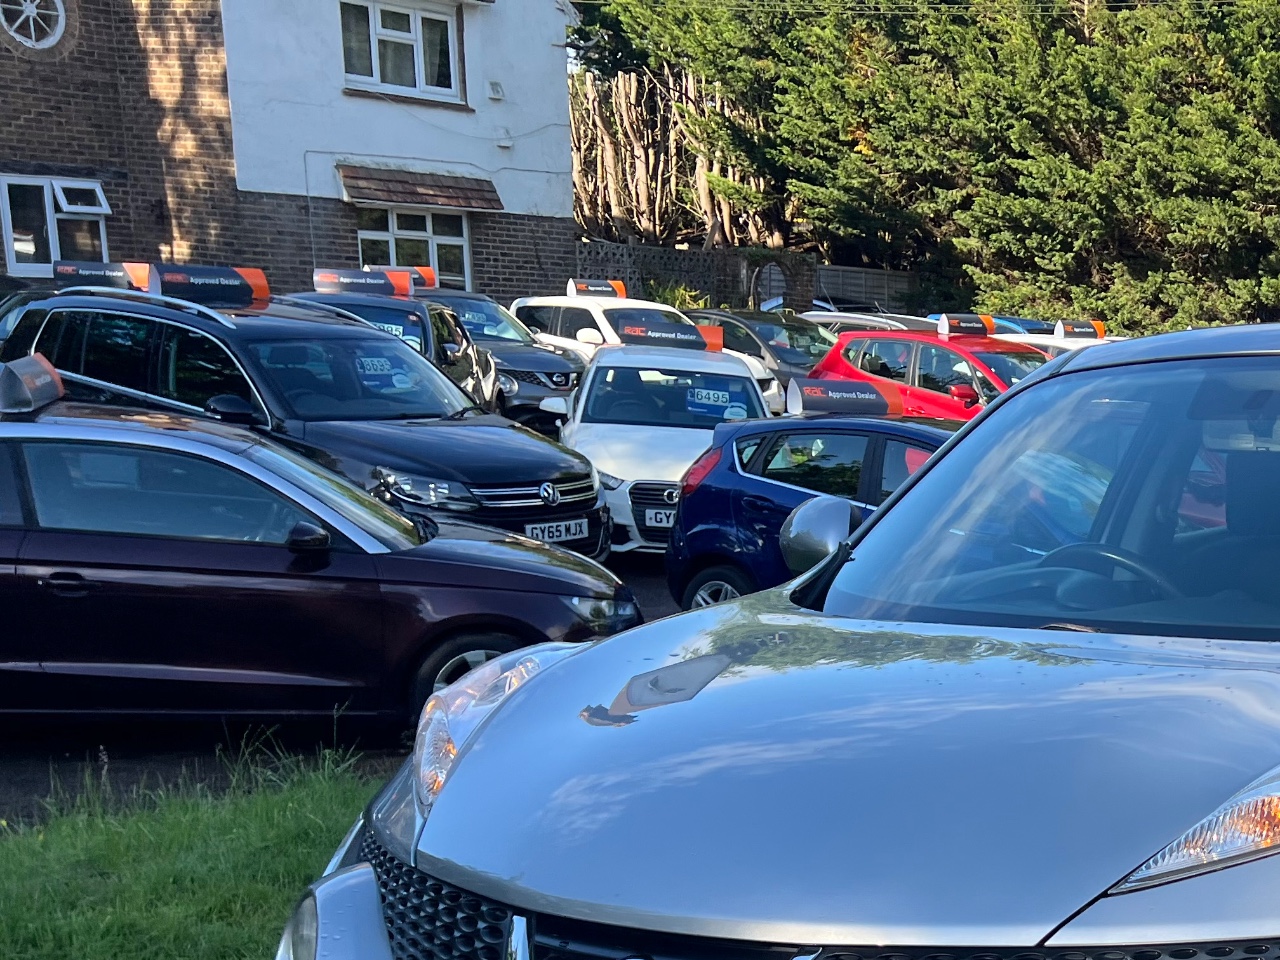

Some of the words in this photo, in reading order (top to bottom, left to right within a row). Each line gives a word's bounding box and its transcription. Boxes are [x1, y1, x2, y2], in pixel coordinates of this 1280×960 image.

[829, 391, 856, 399] Approved
[531, 525, 562, 539] GY65
[564, 523, 584, 538] MJX
